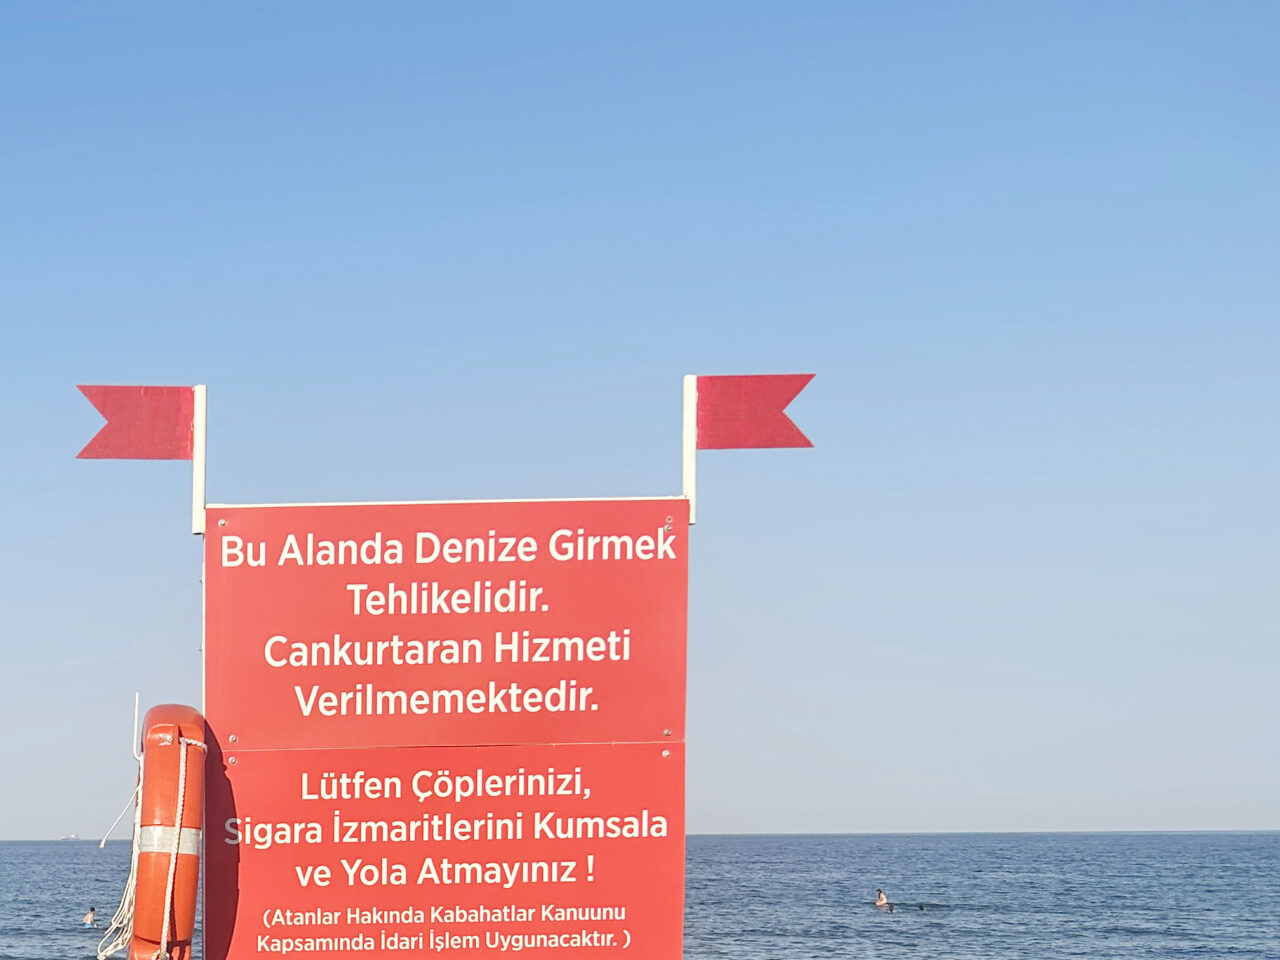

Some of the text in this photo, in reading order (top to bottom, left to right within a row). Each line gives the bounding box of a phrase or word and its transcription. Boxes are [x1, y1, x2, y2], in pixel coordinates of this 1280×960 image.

[221, 528, 677, 568] Bu Alanda Denize Girmek
[346, 579, 549, 616] Tehlikelidir.
[264, 628, 631, 668] Cankurtaran Hizmeti
[294, 680, 599, 717] Verilmemektedir.
[301, 766, 591, 803] Lütfen Çöplerinizi,
[224, 809, 668, 848] Sigara İzmaritlerini Kumsala
[295, 854, 595, 889] ve Yola Atmayınız !
[263, 903, 626, 929] (Atanlar Hakında Kabahatlar Kanuunu
[257, 933, 375, 955] Kapsamında
[380, 929, 424, 951] İdari
[429, 929, 480, 952] İşlem
[485, 928, 618, 952] Uygunacaktır.
